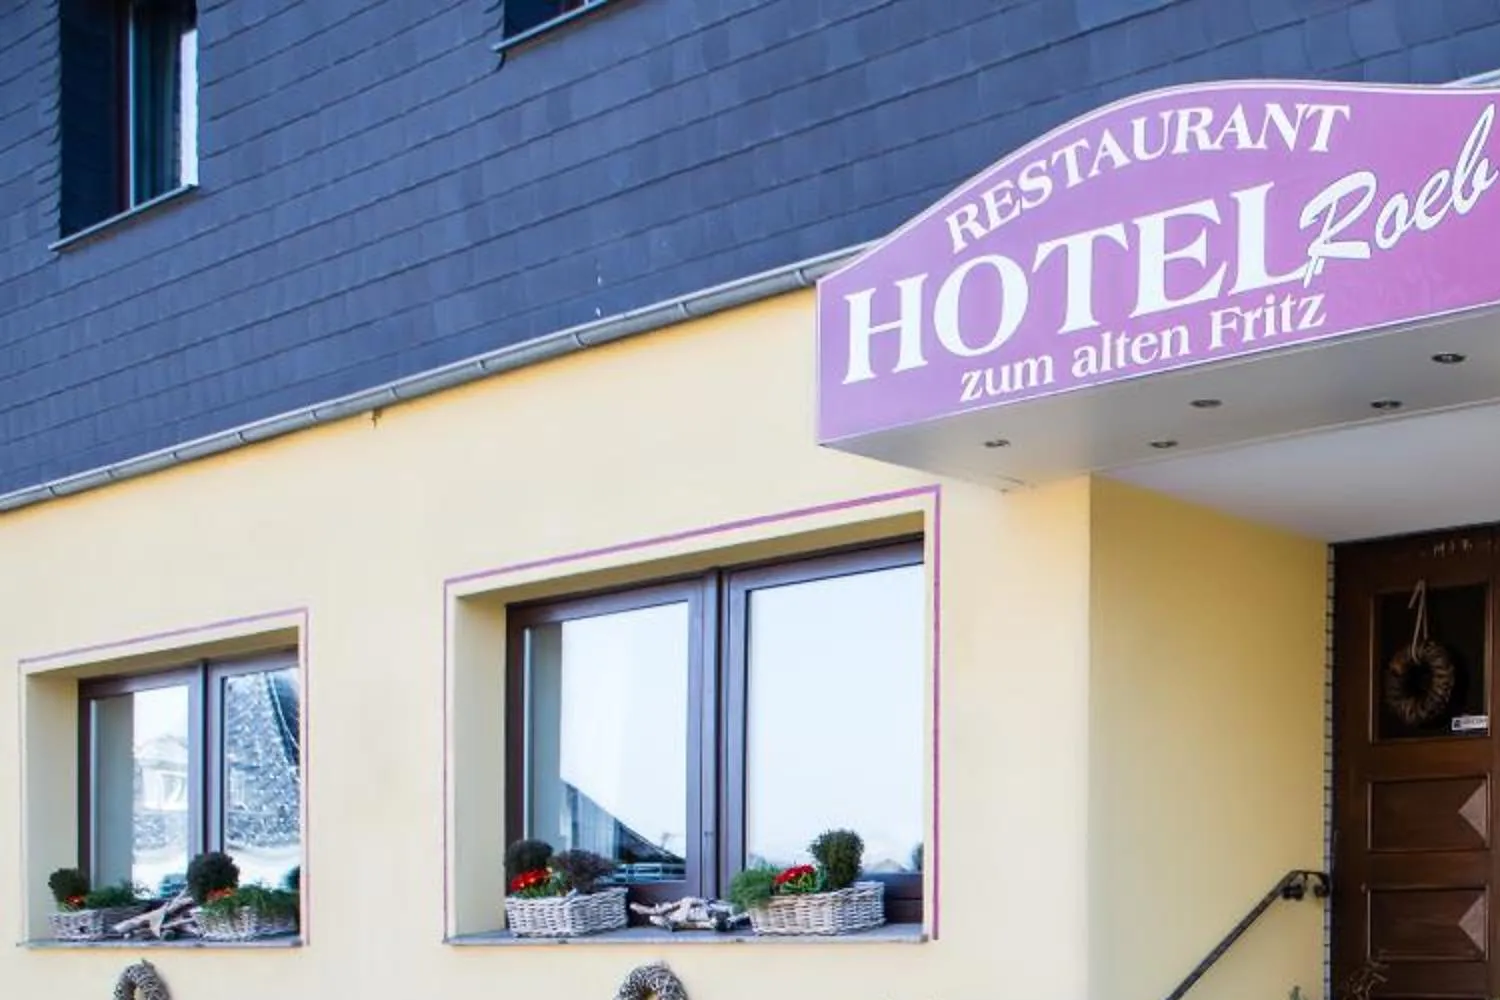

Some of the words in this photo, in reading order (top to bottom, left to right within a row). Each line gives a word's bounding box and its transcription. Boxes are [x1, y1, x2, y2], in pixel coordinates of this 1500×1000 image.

[841, 182, 1304, 384] HOTEL
[1296, 102, 1500, 290] Roeb
[944, 102, 1350, 254] RESTAURANT
[959, 352, 1055, 403] zum
[1071, 323, 1191, 379] alten
[1208, 290, 1328, 359] Fritz
